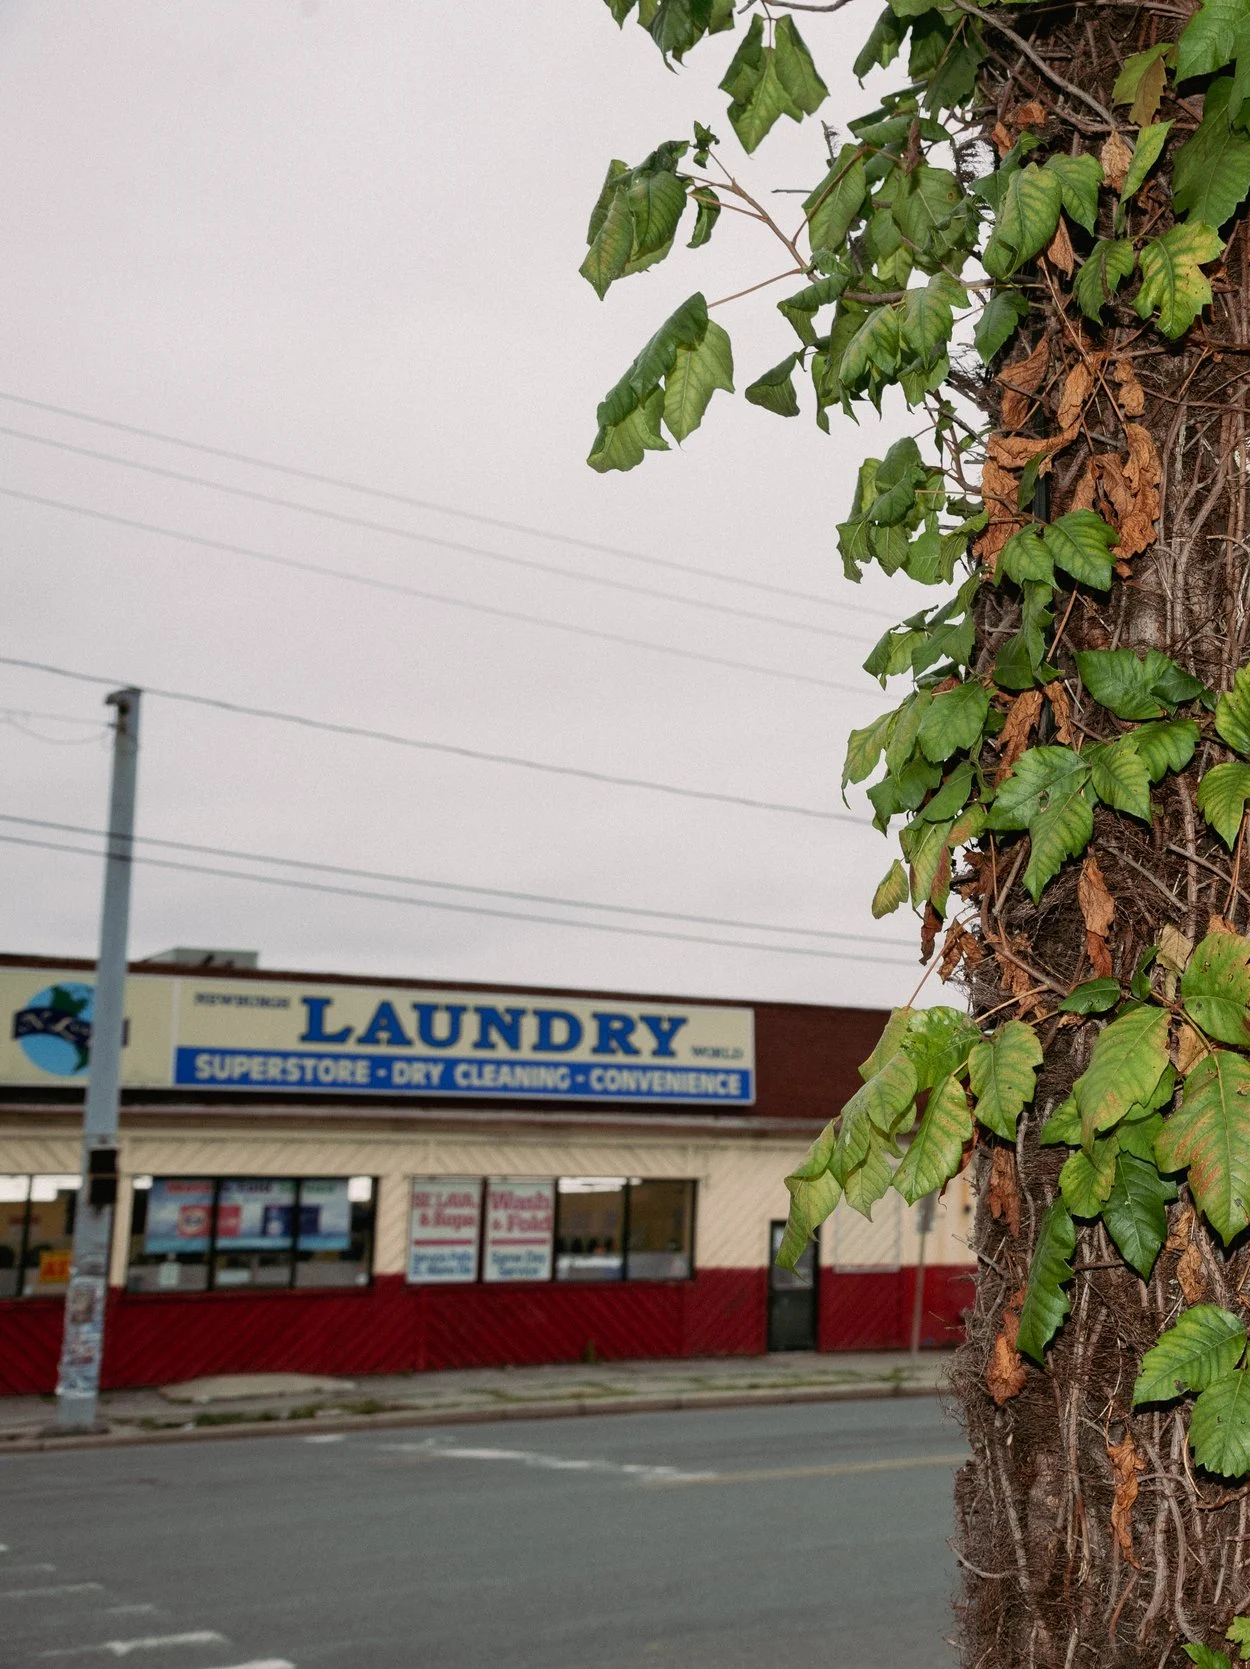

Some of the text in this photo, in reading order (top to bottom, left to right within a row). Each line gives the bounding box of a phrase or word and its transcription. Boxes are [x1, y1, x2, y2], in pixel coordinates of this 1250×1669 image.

[300, 995, 688, 1059] LAUNDRY
[194, 1053, 742, 1096] SUPERSTORE DRY CLEANING CONVENIENCE
